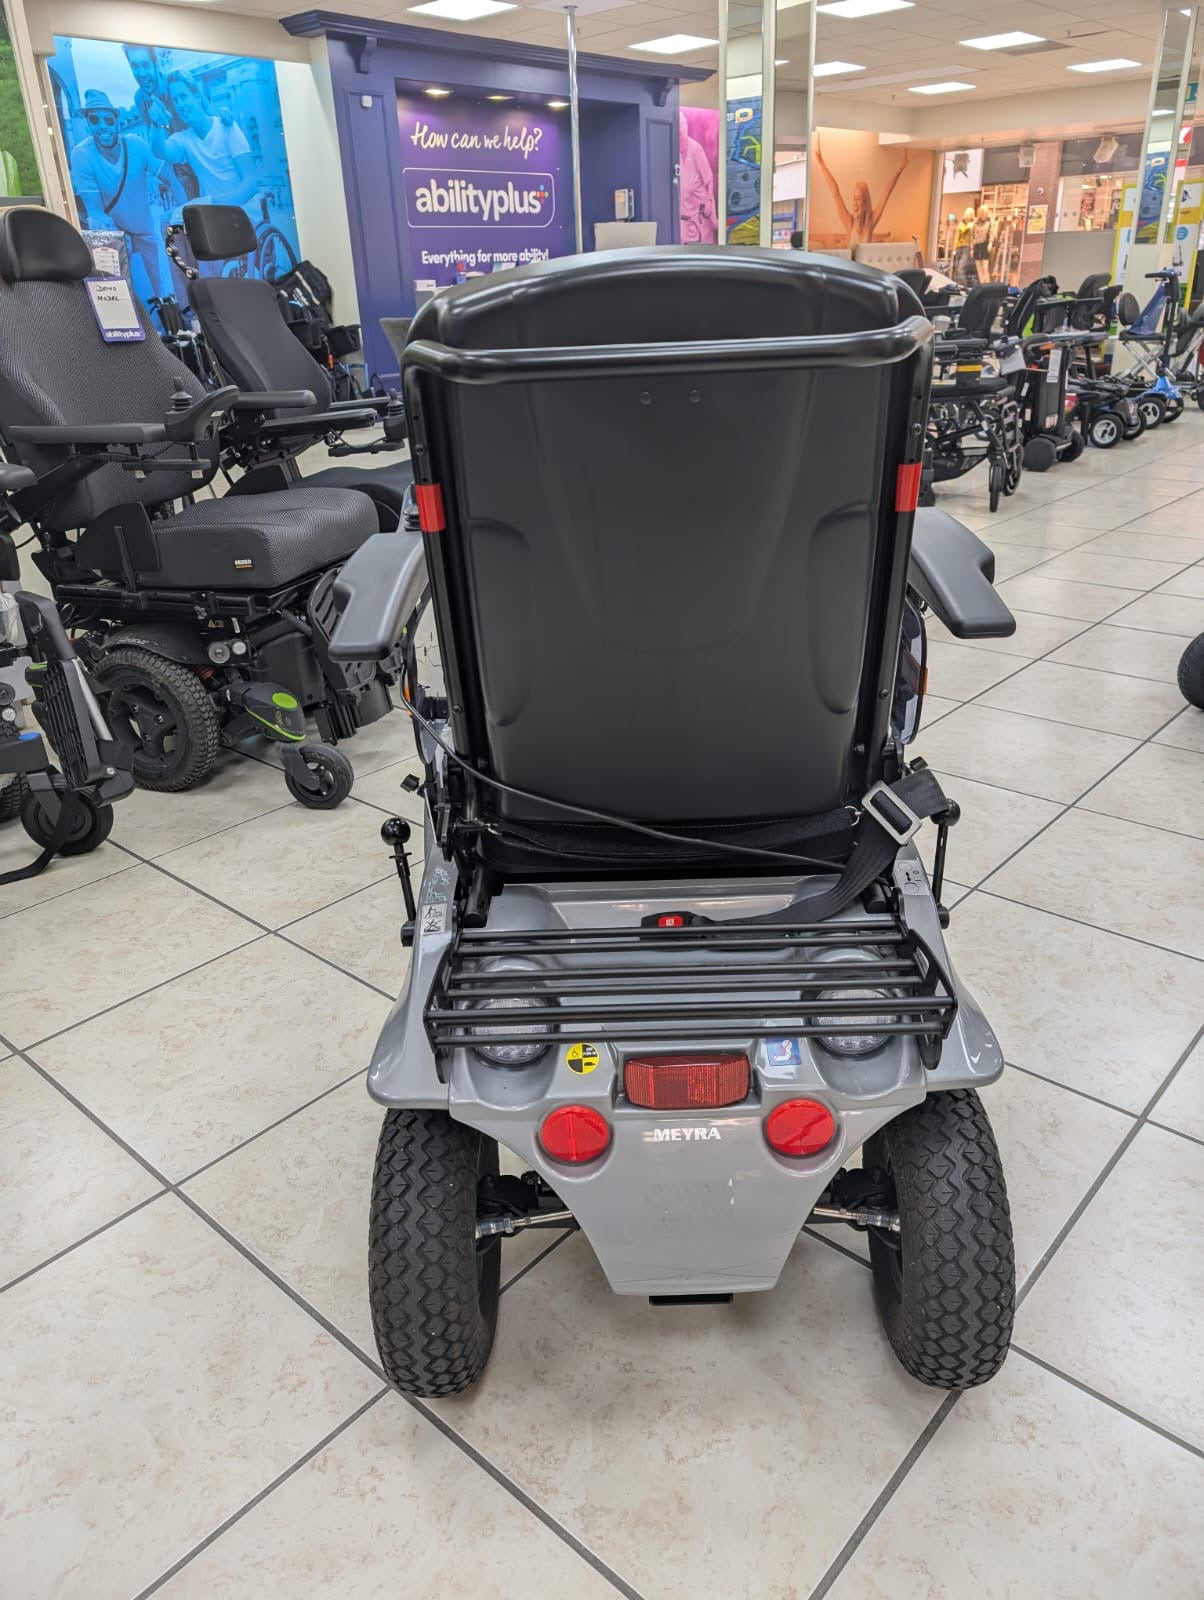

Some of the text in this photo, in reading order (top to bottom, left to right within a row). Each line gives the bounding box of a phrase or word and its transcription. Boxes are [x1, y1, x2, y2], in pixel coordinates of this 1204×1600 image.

[410, 121, 543, 159] How can we help?
[415, 178, 543, 221] abilityplus
[421, 249, 477, 267] Everything
[477, 249, 493, 262] for
[493, 252, 518, 263] more
[654, 1127, 722, 1142] MEYRA
